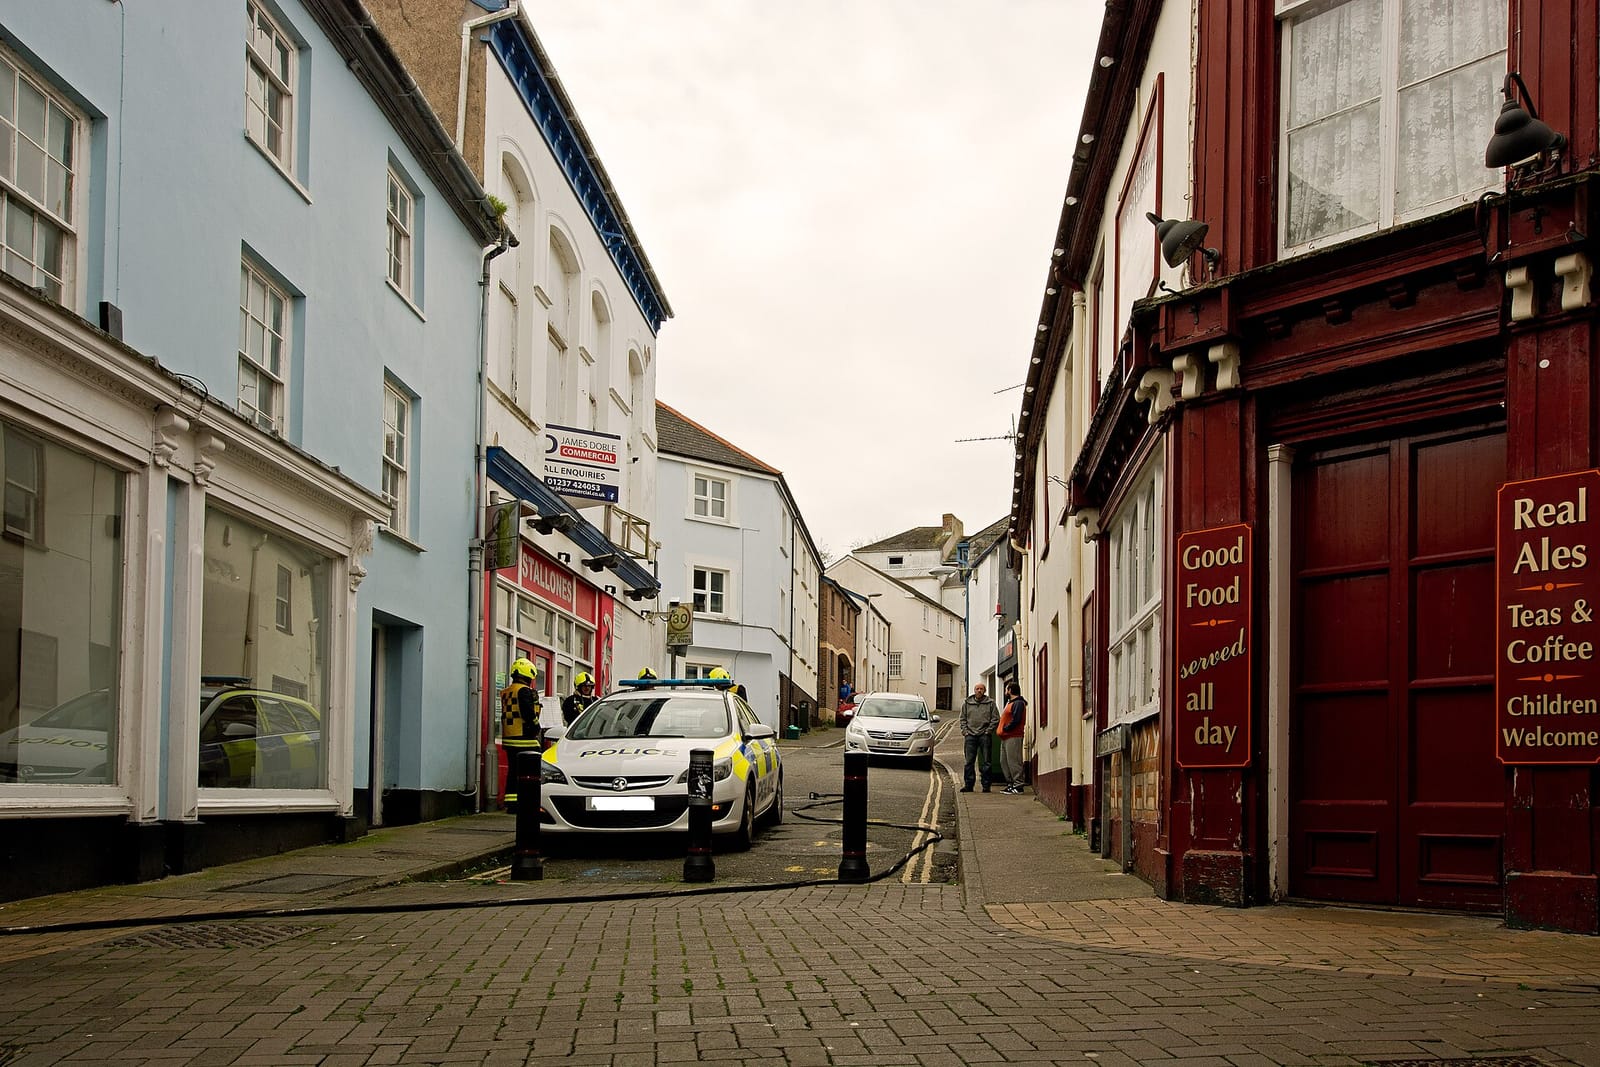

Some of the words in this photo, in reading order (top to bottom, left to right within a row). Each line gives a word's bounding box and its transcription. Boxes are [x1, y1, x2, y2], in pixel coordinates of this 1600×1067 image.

[561, 437, 588, 448] JAMES
[590, 441, 616, 452] DOBLE
[562, 448, 614, 462] COMMERCIAL
[547, 478, 571, 487] 01237
[573, 481, 600, 491] 424053
[561, 467, 605, 480] ENQUIRIES
[1513, 487, 1587, 530] Real
[1182, 536, 1243, 570] Good
[1513, 536, 1587, 574] Ales
[522, 553, 572, 602] STALLONES
[1186, 575, 1240, 608] Food
[672, 613, 688, 624] 30
[1507, 604, 1562, 628] Teas
[1571, 598, 1593, 624] &
[1180, 627, 1246, 679] served
[1507, 634, 1593, 664] Coffee
[1186, 682, 1213, 711] all
[1507, 693, 1597, 716] Children
[1194, 716, 1237, 752] day
[1502, 726, 1599, 747] Welcome
[580, 748, 679, 757] POLICE
